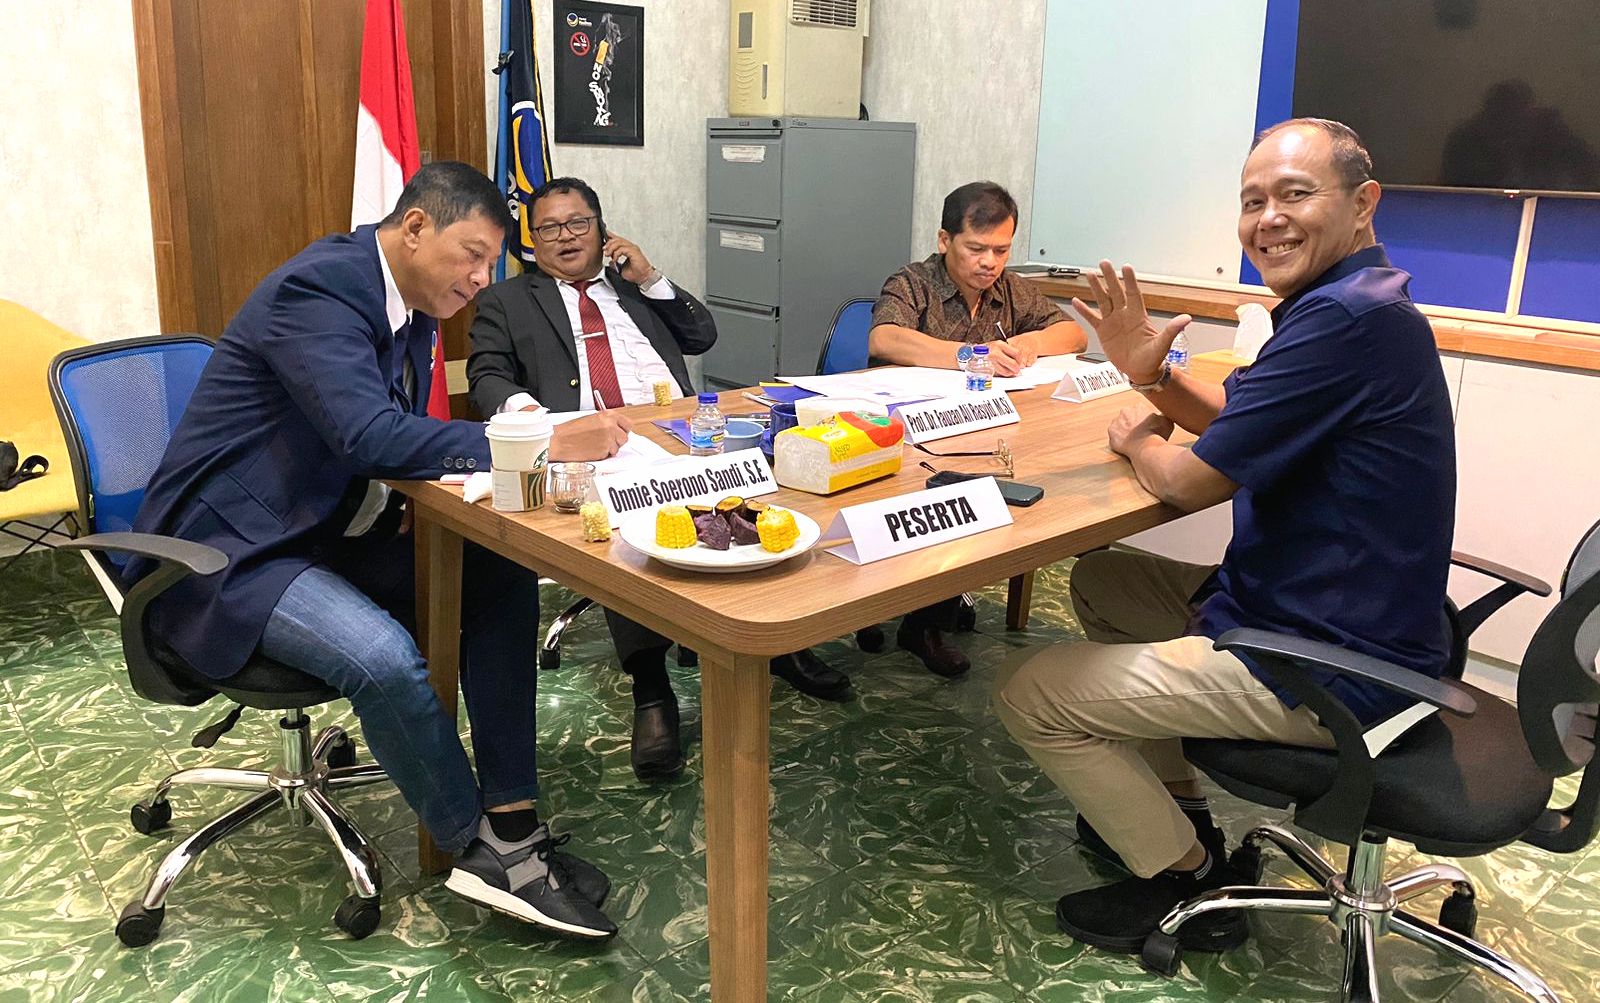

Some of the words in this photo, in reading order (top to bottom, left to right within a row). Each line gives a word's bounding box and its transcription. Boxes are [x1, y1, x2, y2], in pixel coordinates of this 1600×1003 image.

[592, 62, 603, 81] NO
[906, 412, 929, 434] Prof.
[923, 411, 940, 430] Dr.
[933, 408, 964, 427] Fauzan
[958, 404, 974, 423] Ali
[608, 482, 653, 514] Onnie
[650, 474, 709, 505] Soerono
[705, 463, 749, 493] Sandi,
[743, 459, 769, 484] S.E.
[884, 496, 978, 542] PESERTA
